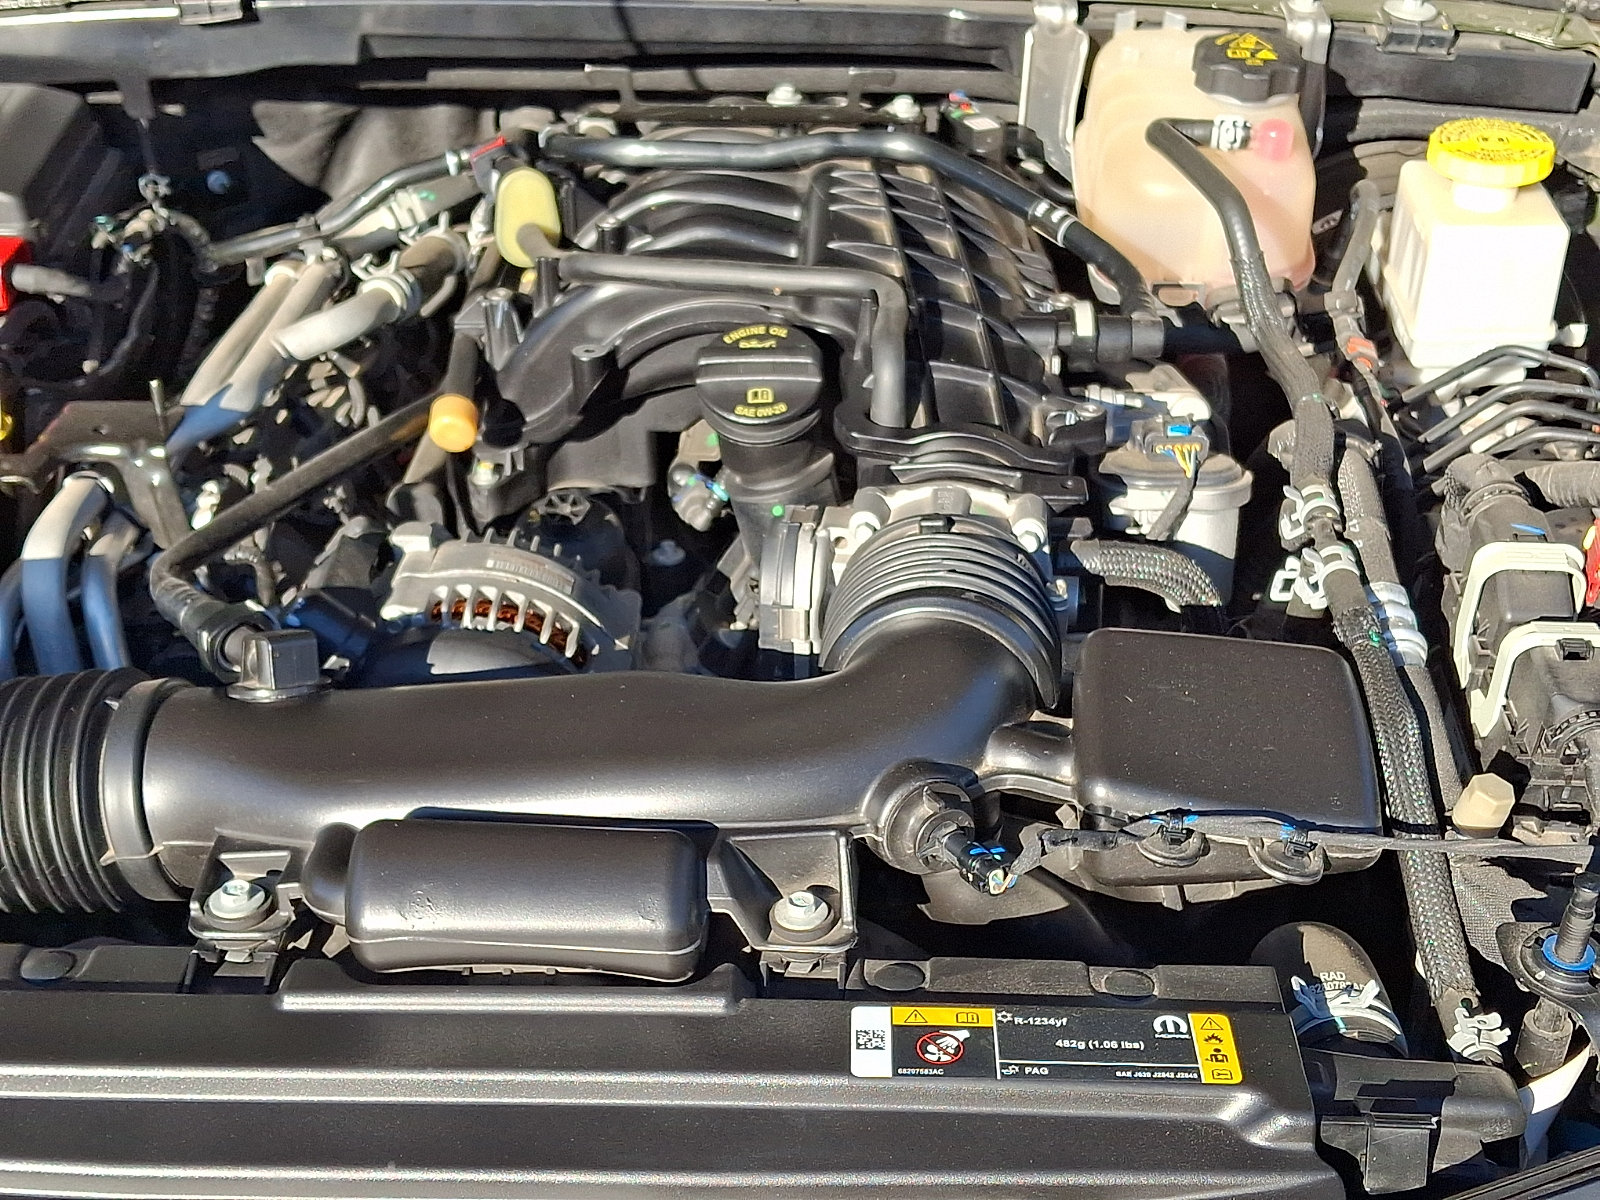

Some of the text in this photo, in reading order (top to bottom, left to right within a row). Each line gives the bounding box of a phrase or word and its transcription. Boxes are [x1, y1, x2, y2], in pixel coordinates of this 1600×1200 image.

[723, 325, 788, 344] ENGINE OIL
[734, 402, 788, 417] SAE 0W-20
[1319, 971, 1346, 981] RAD
[1014, 1016, 1068, 1028] R-1234yf
[1055, 1039, 1145, 1051] 482g (1.06 lbs)
[1024, 1066, 1049, 1075] PAG
